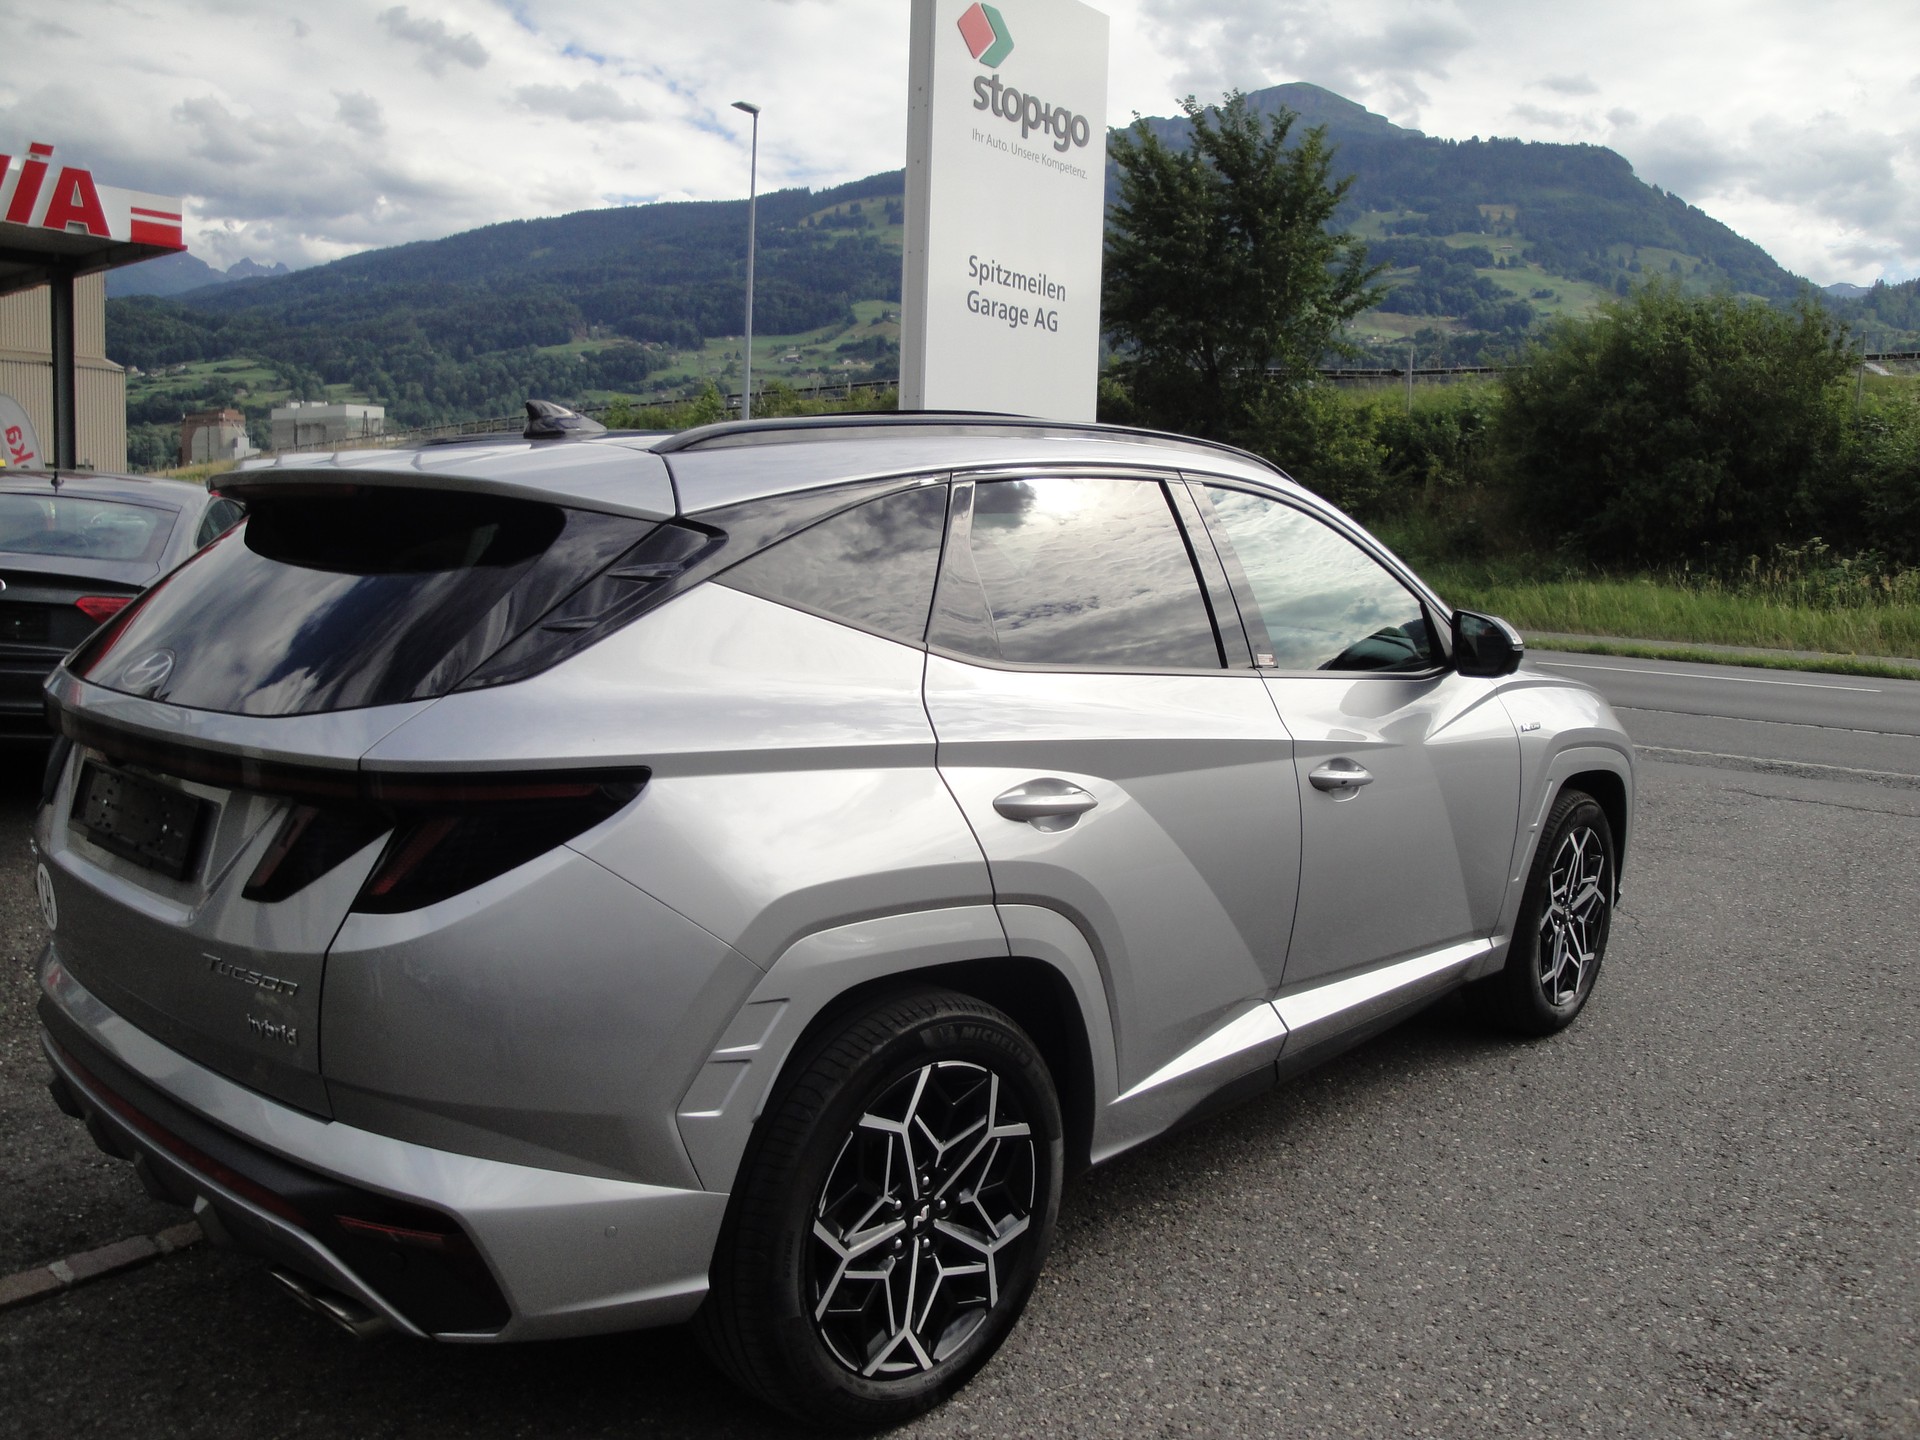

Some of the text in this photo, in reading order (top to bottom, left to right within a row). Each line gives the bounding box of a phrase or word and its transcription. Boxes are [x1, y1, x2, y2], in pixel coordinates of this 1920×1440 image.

[973, 74, 1090, 152] stop+go
[972, 128, 1088, 180] Ihr Auto. Unsere Kompetenz.
[0, 142, 112, 238] iA
[968, 254, 1066, 302] Spitzmeilen
[967, 290, 1058, 332] Garage AG
